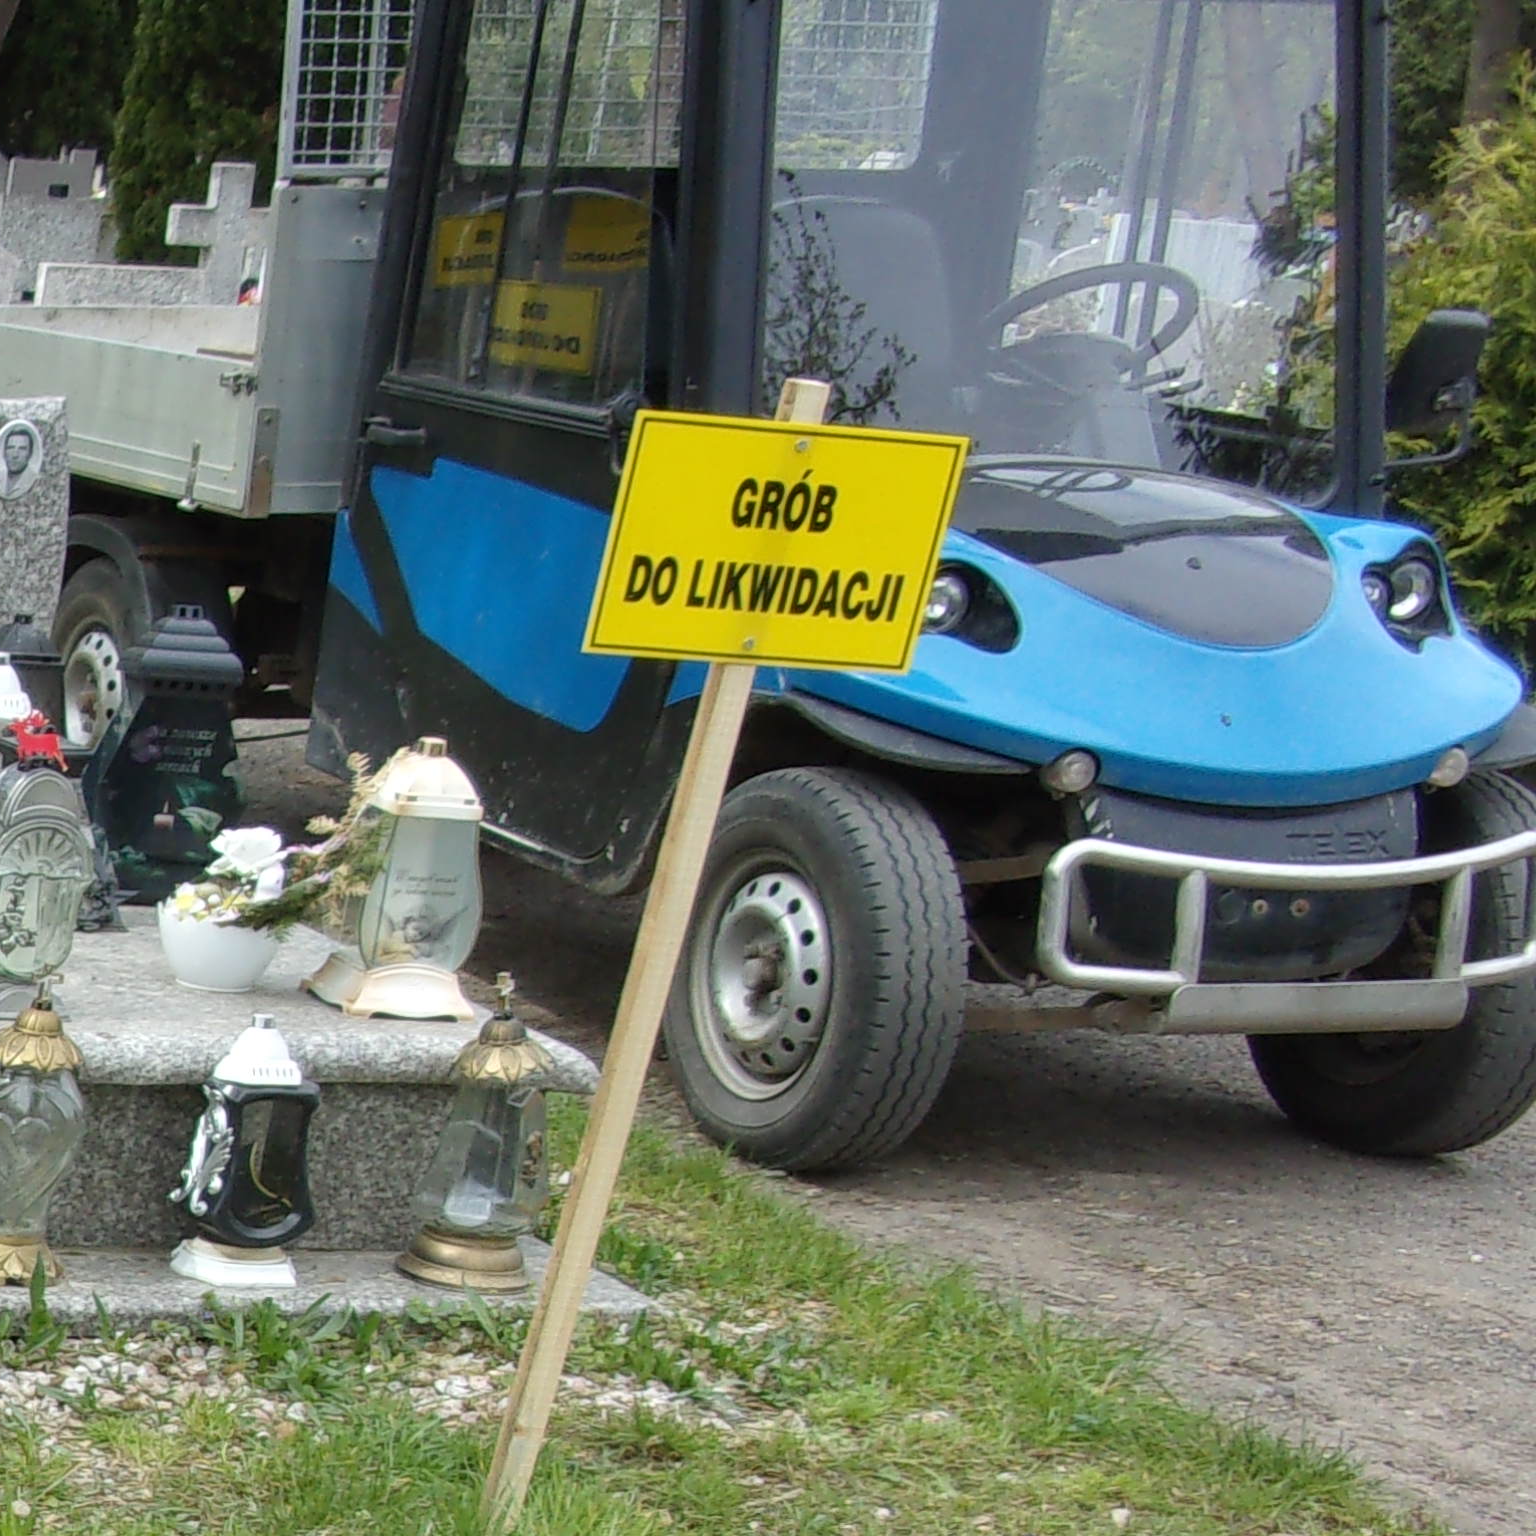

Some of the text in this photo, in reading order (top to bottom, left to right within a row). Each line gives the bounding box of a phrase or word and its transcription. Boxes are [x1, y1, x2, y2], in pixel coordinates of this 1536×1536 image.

[730, 470, 839, 533] GRÓB
[623, 554, 905, 623] DO LIKWIDACJI
